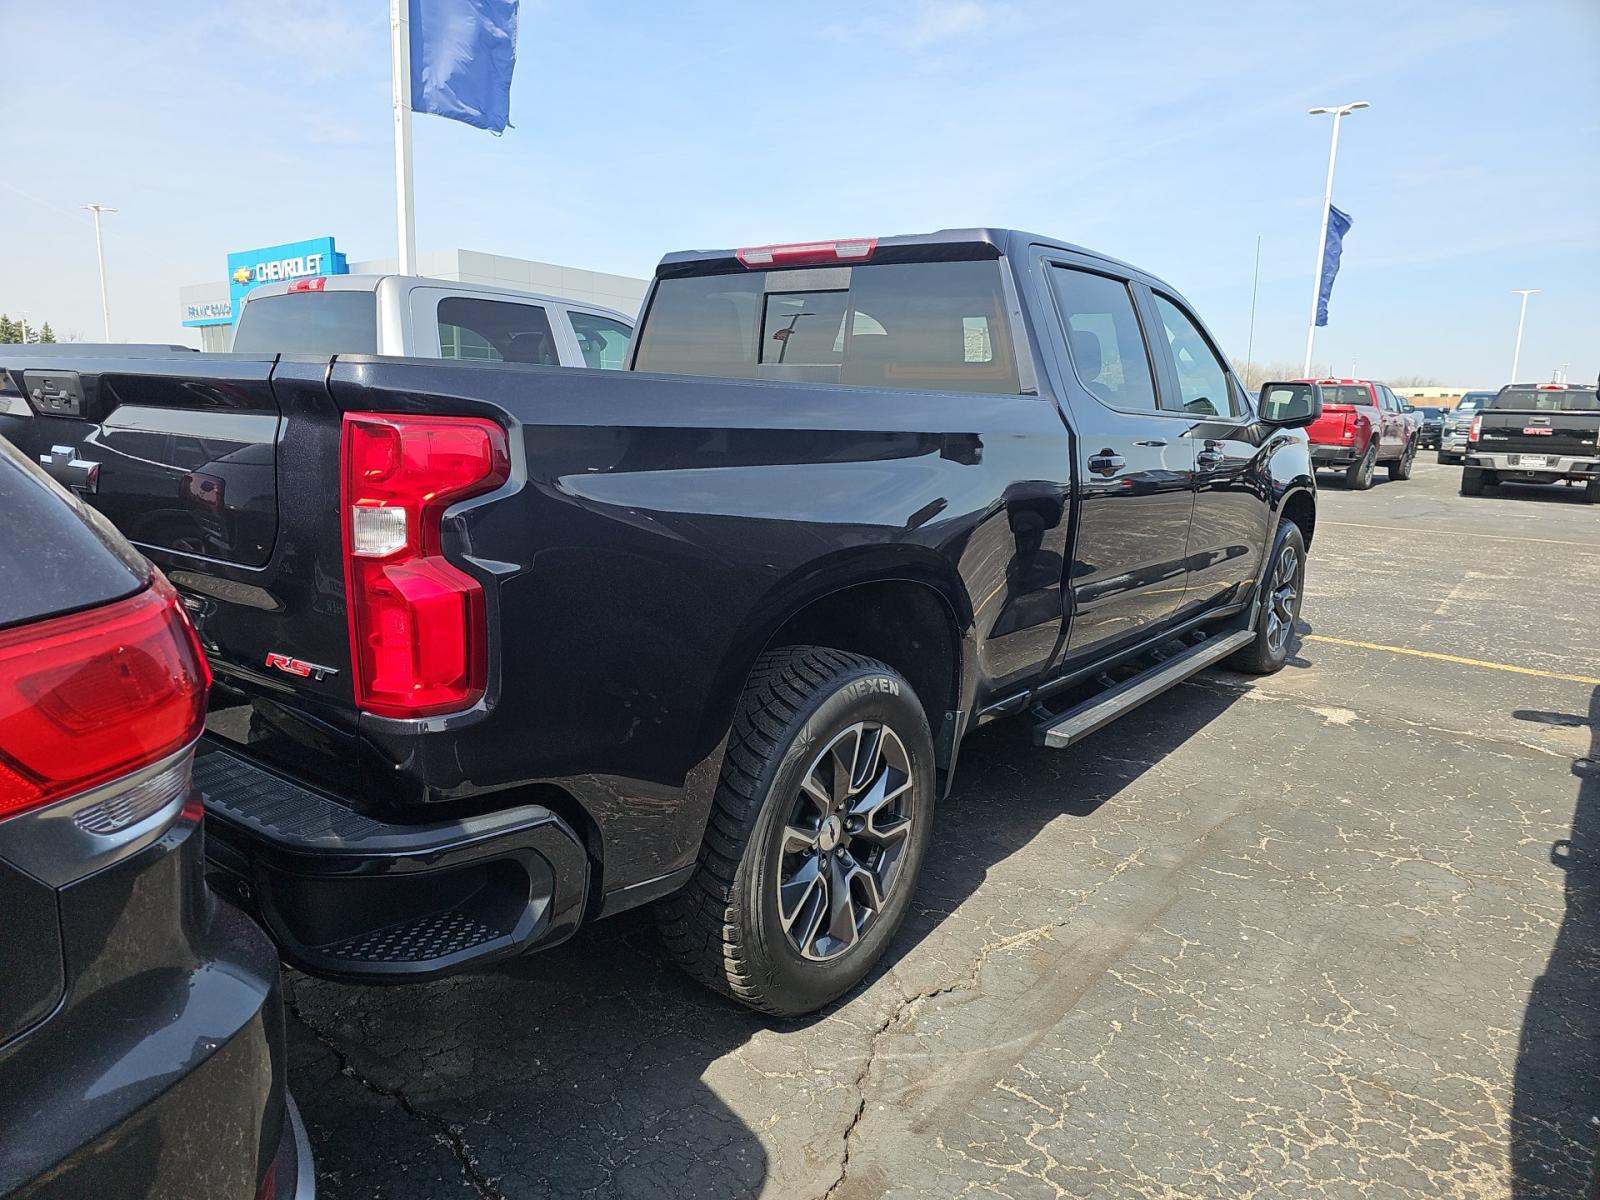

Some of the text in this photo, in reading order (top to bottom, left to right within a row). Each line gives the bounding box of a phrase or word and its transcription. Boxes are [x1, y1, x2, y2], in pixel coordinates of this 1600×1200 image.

[256, 254, 322, 281] CHEVROLET
[265, 652, 340, 681] RST
[840, 678, 899, 705] NEXEN
